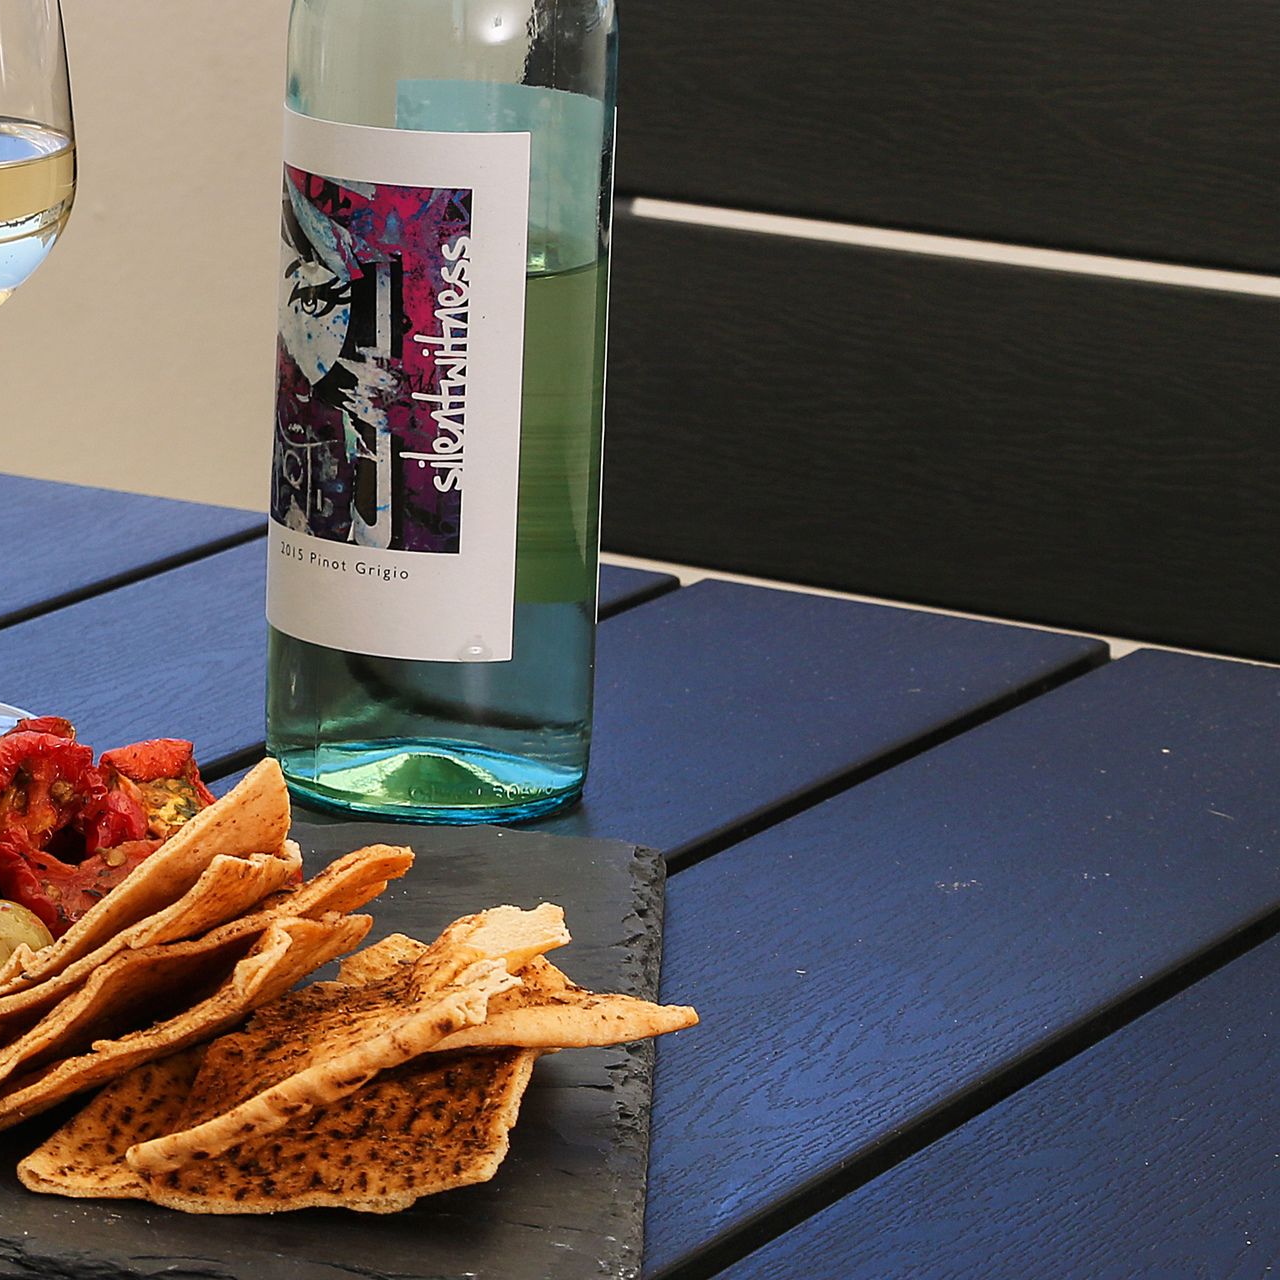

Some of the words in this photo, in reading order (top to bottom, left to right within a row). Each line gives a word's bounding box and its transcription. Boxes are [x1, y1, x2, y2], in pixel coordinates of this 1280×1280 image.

[281, 541, 303, 561] 2015
[310, 552, 346, 571] Pinot
[355, 562, 409, 581] Grigio
